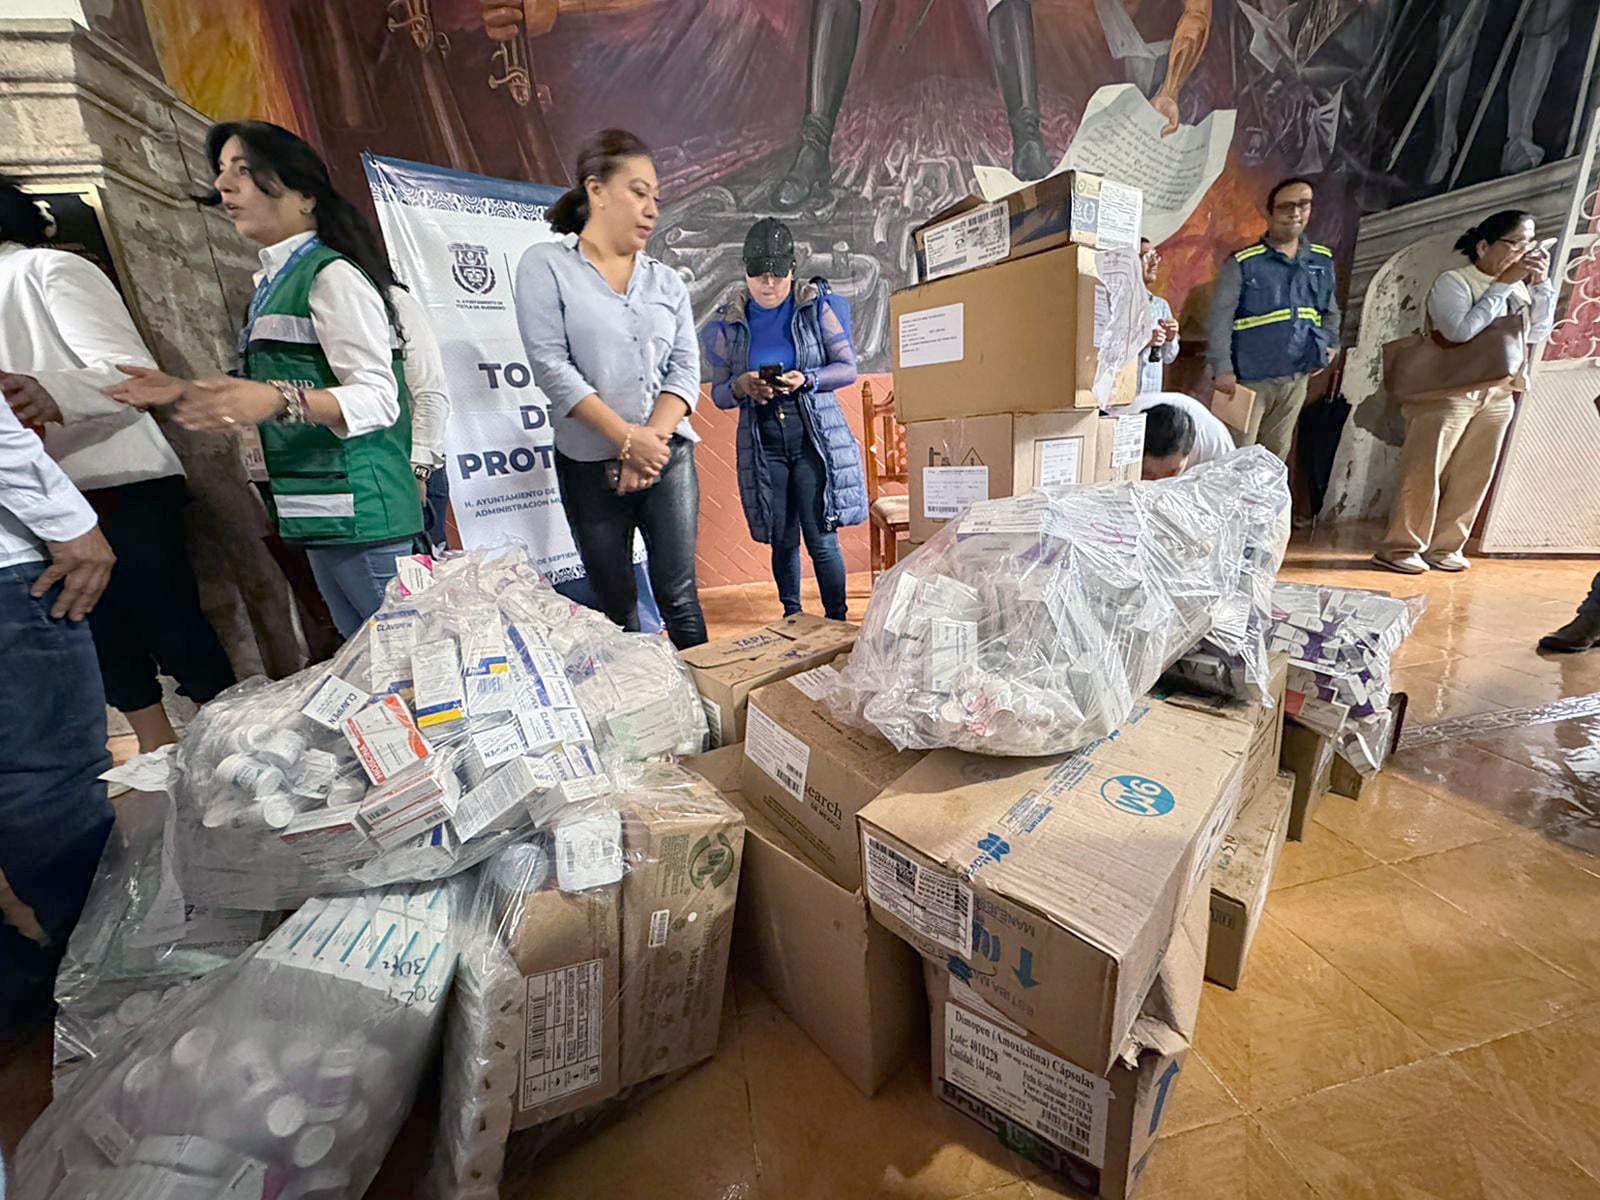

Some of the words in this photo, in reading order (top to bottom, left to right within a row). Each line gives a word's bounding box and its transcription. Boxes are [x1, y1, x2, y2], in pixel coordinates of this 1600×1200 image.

[478, 362, 538, 388] TO
[475, 499, 549, 518] ADMINISTRACIÓN
[476, 490, 544, 507] AYUNTAMIENTO
[545, 487, 556, 495] DE
[328, 692, 358, 725] CLAVIPEN
[540, 711, 556, 739] CLAVIPEN
[570, 712, 585, 738] CLAVIPEN
[955, 1010, 990, 1038] Dimopen
[1052, 1060, 1095, 1090] Cápsulas
